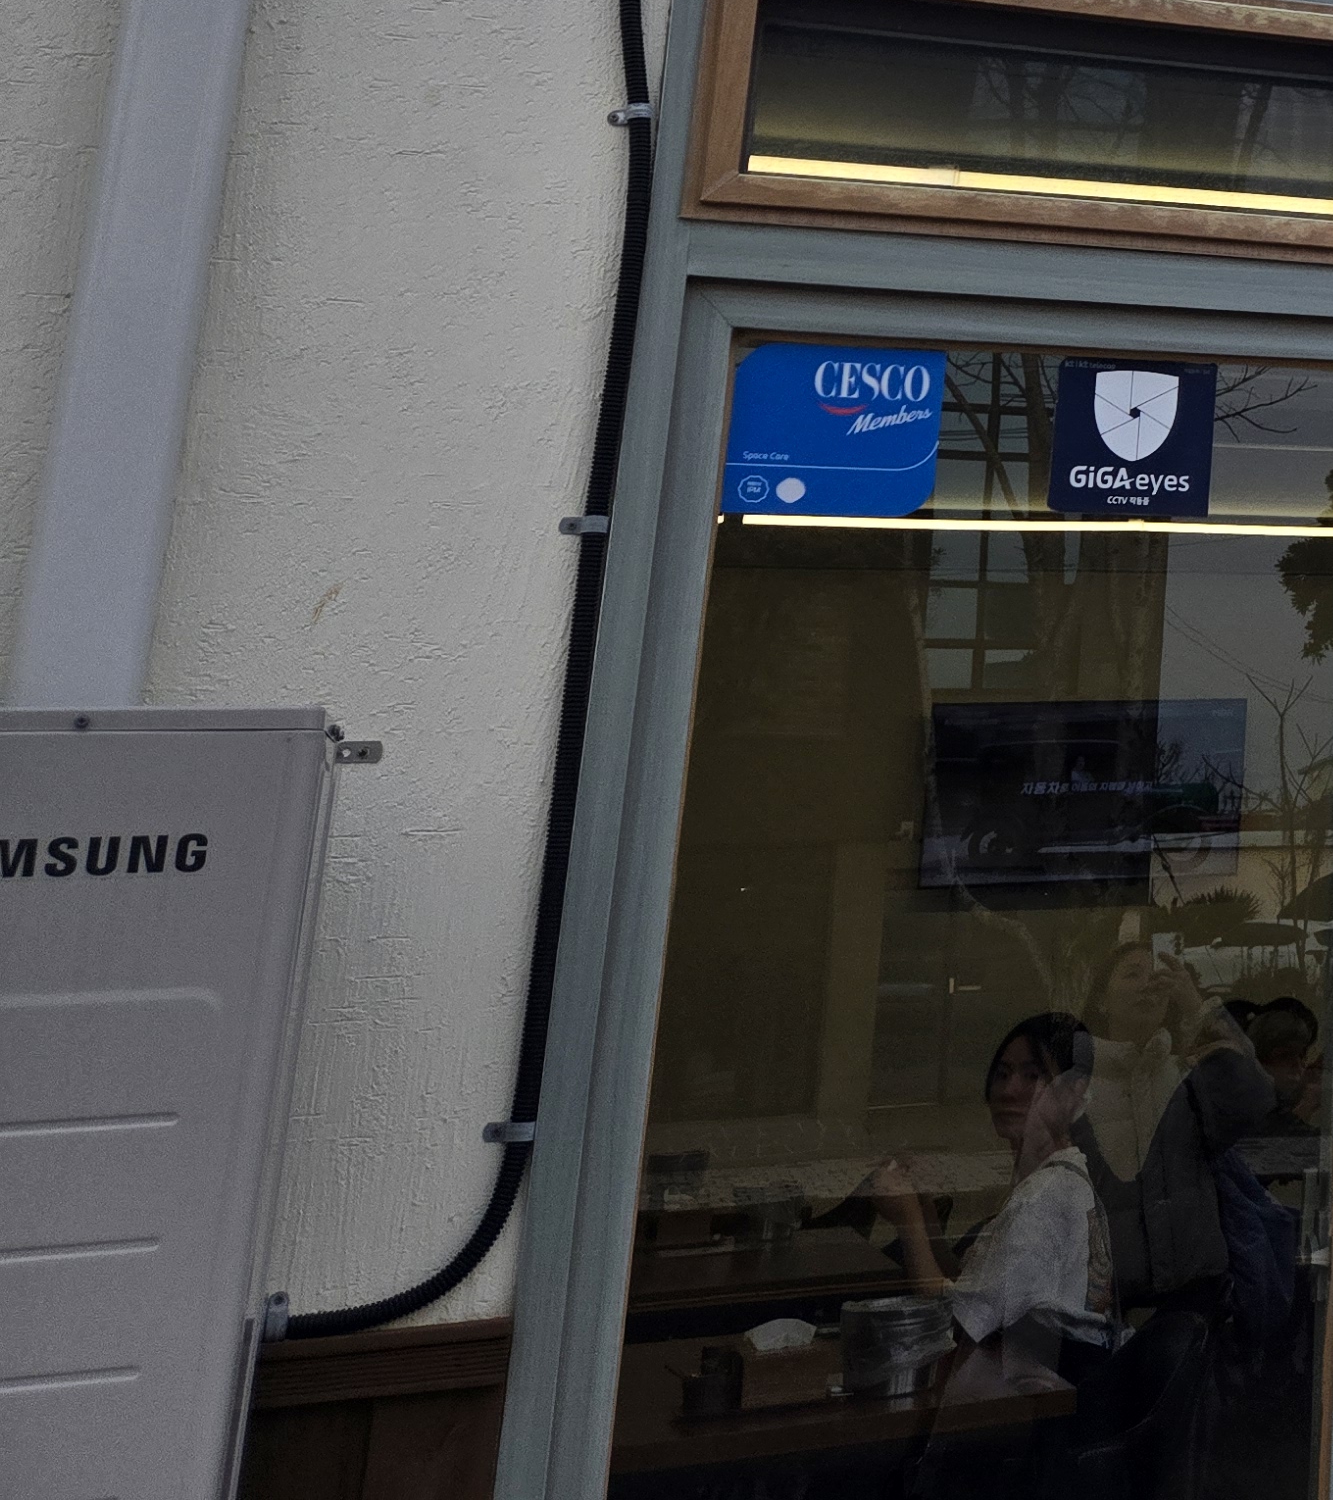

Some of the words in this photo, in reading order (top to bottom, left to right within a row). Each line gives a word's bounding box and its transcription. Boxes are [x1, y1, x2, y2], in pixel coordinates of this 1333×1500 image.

[814, 360, 931, 402] CESCO
[846, 404, 934, 436] Members
[742, 450, 769, 462] Space
[769, 452, 790, 461] Care
[1106, 495, 1128, 505] CCTV
[0, 833, 208, 878] MSUNG
